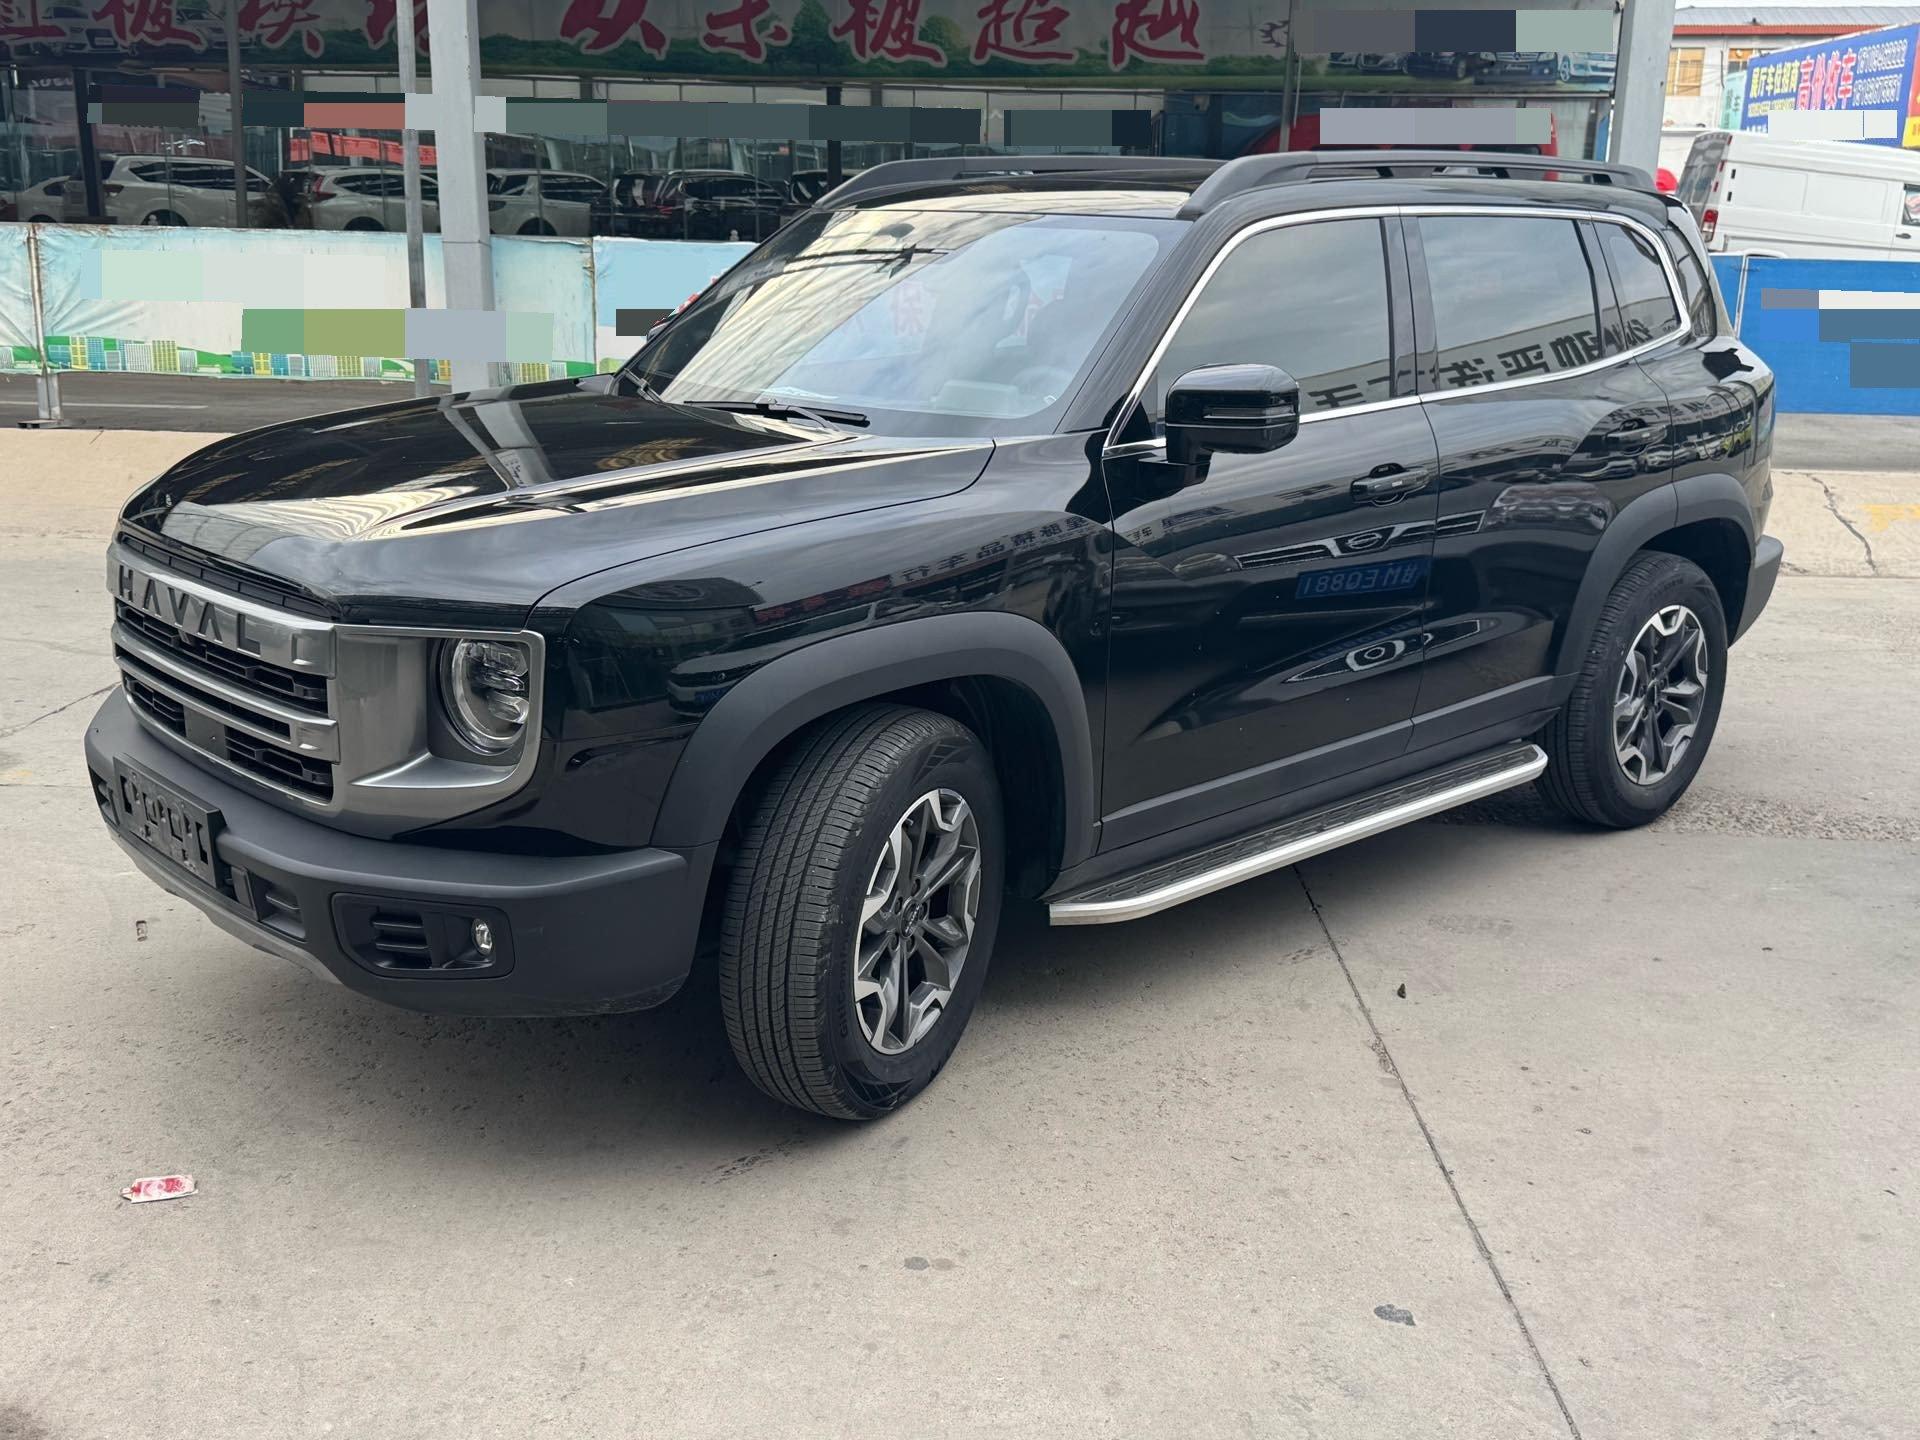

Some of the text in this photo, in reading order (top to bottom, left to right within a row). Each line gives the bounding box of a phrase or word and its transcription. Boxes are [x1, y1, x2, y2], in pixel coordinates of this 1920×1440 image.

[1796, 49, 1857, 110] 高价收车
[119, 564, 261, 658] HAVAL
